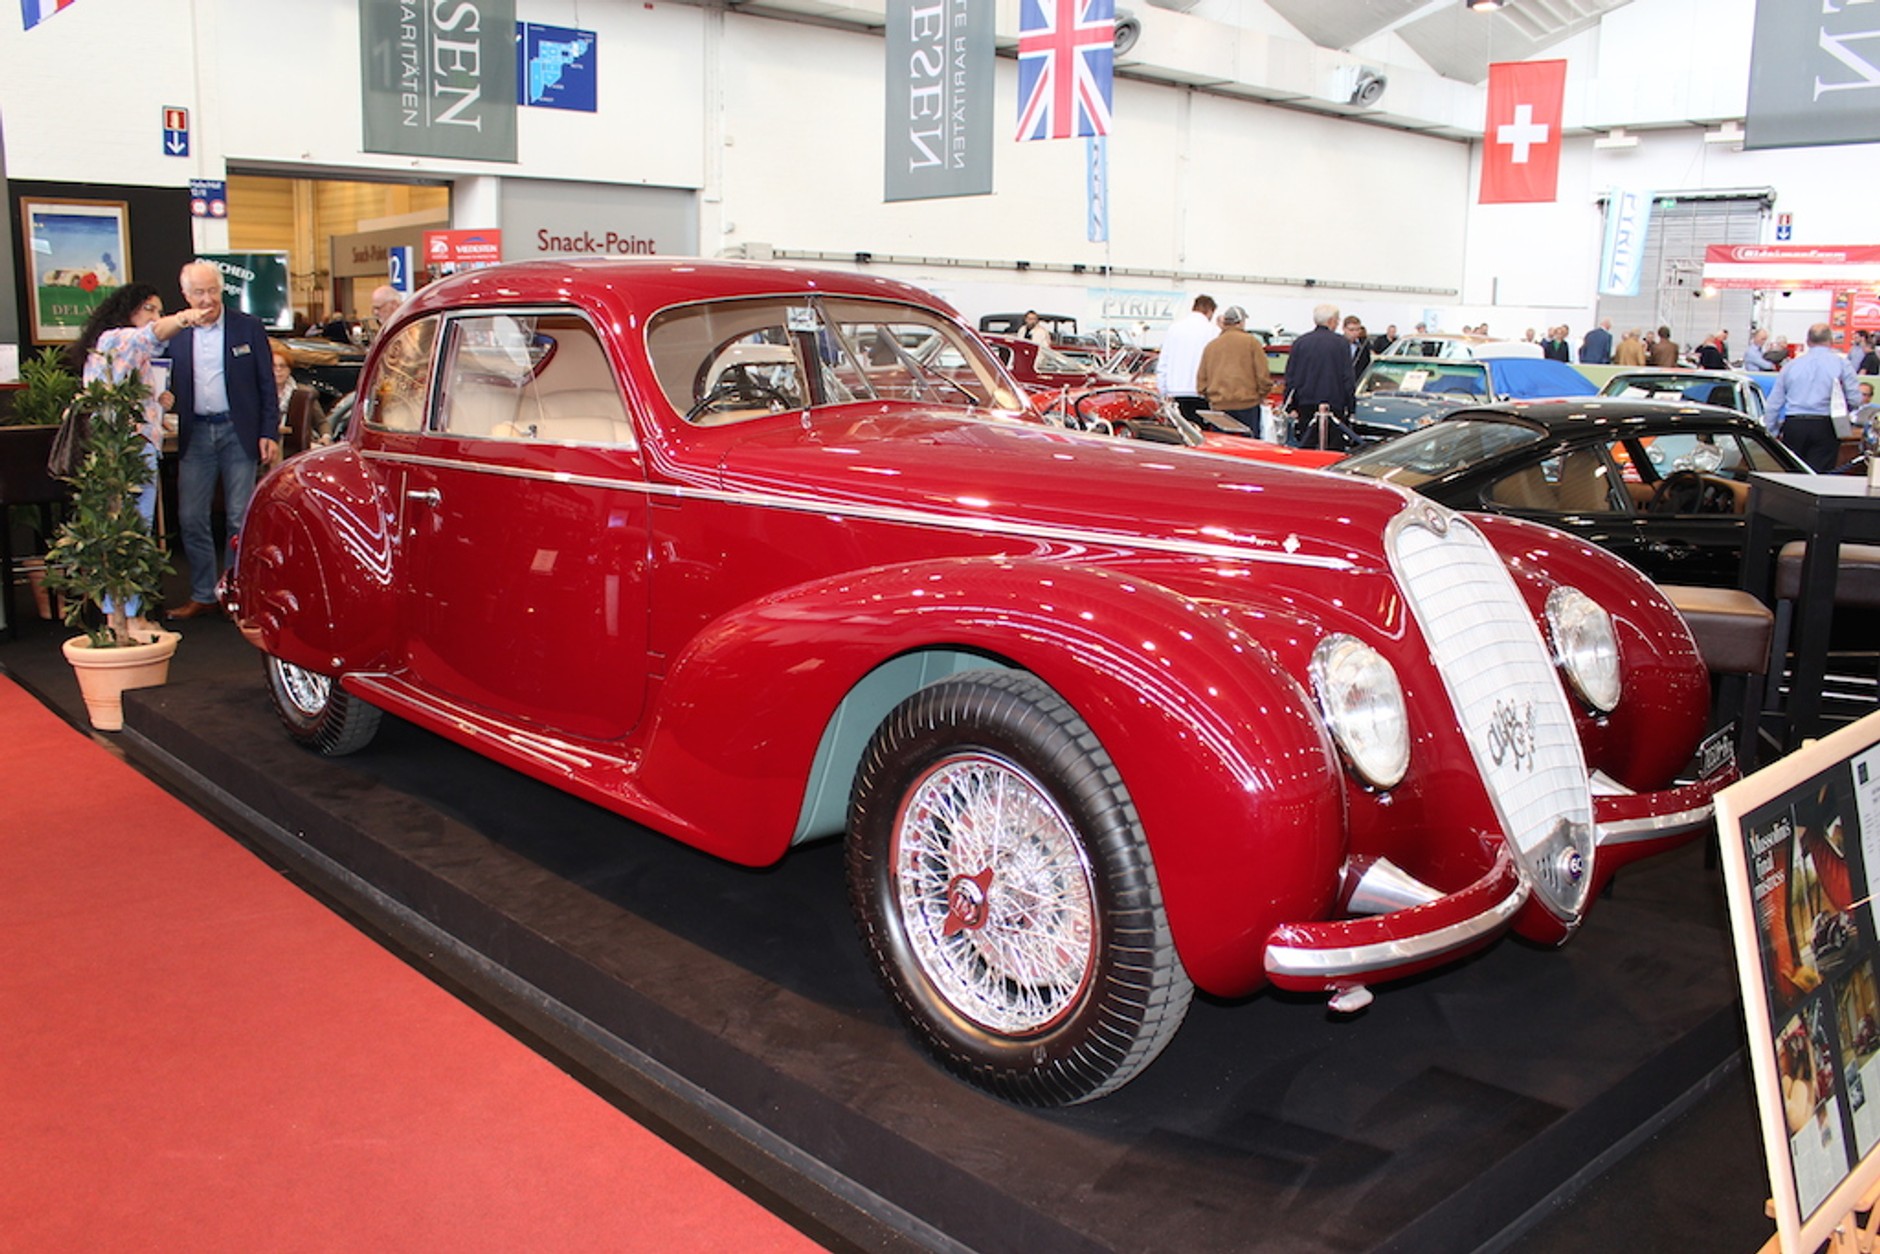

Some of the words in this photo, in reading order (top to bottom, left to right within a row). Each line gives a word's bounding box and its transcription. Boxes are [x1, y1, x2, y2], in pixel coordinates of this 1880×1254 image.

[401, 0, 420, 127] ARITÄTEN
[537, 229, 656, 255] Snack-Point
[390, 255, 402, 284] 2
[51, 303, 97, 316] DELA
[1102, 298, 1174, 317] PYRITZ
